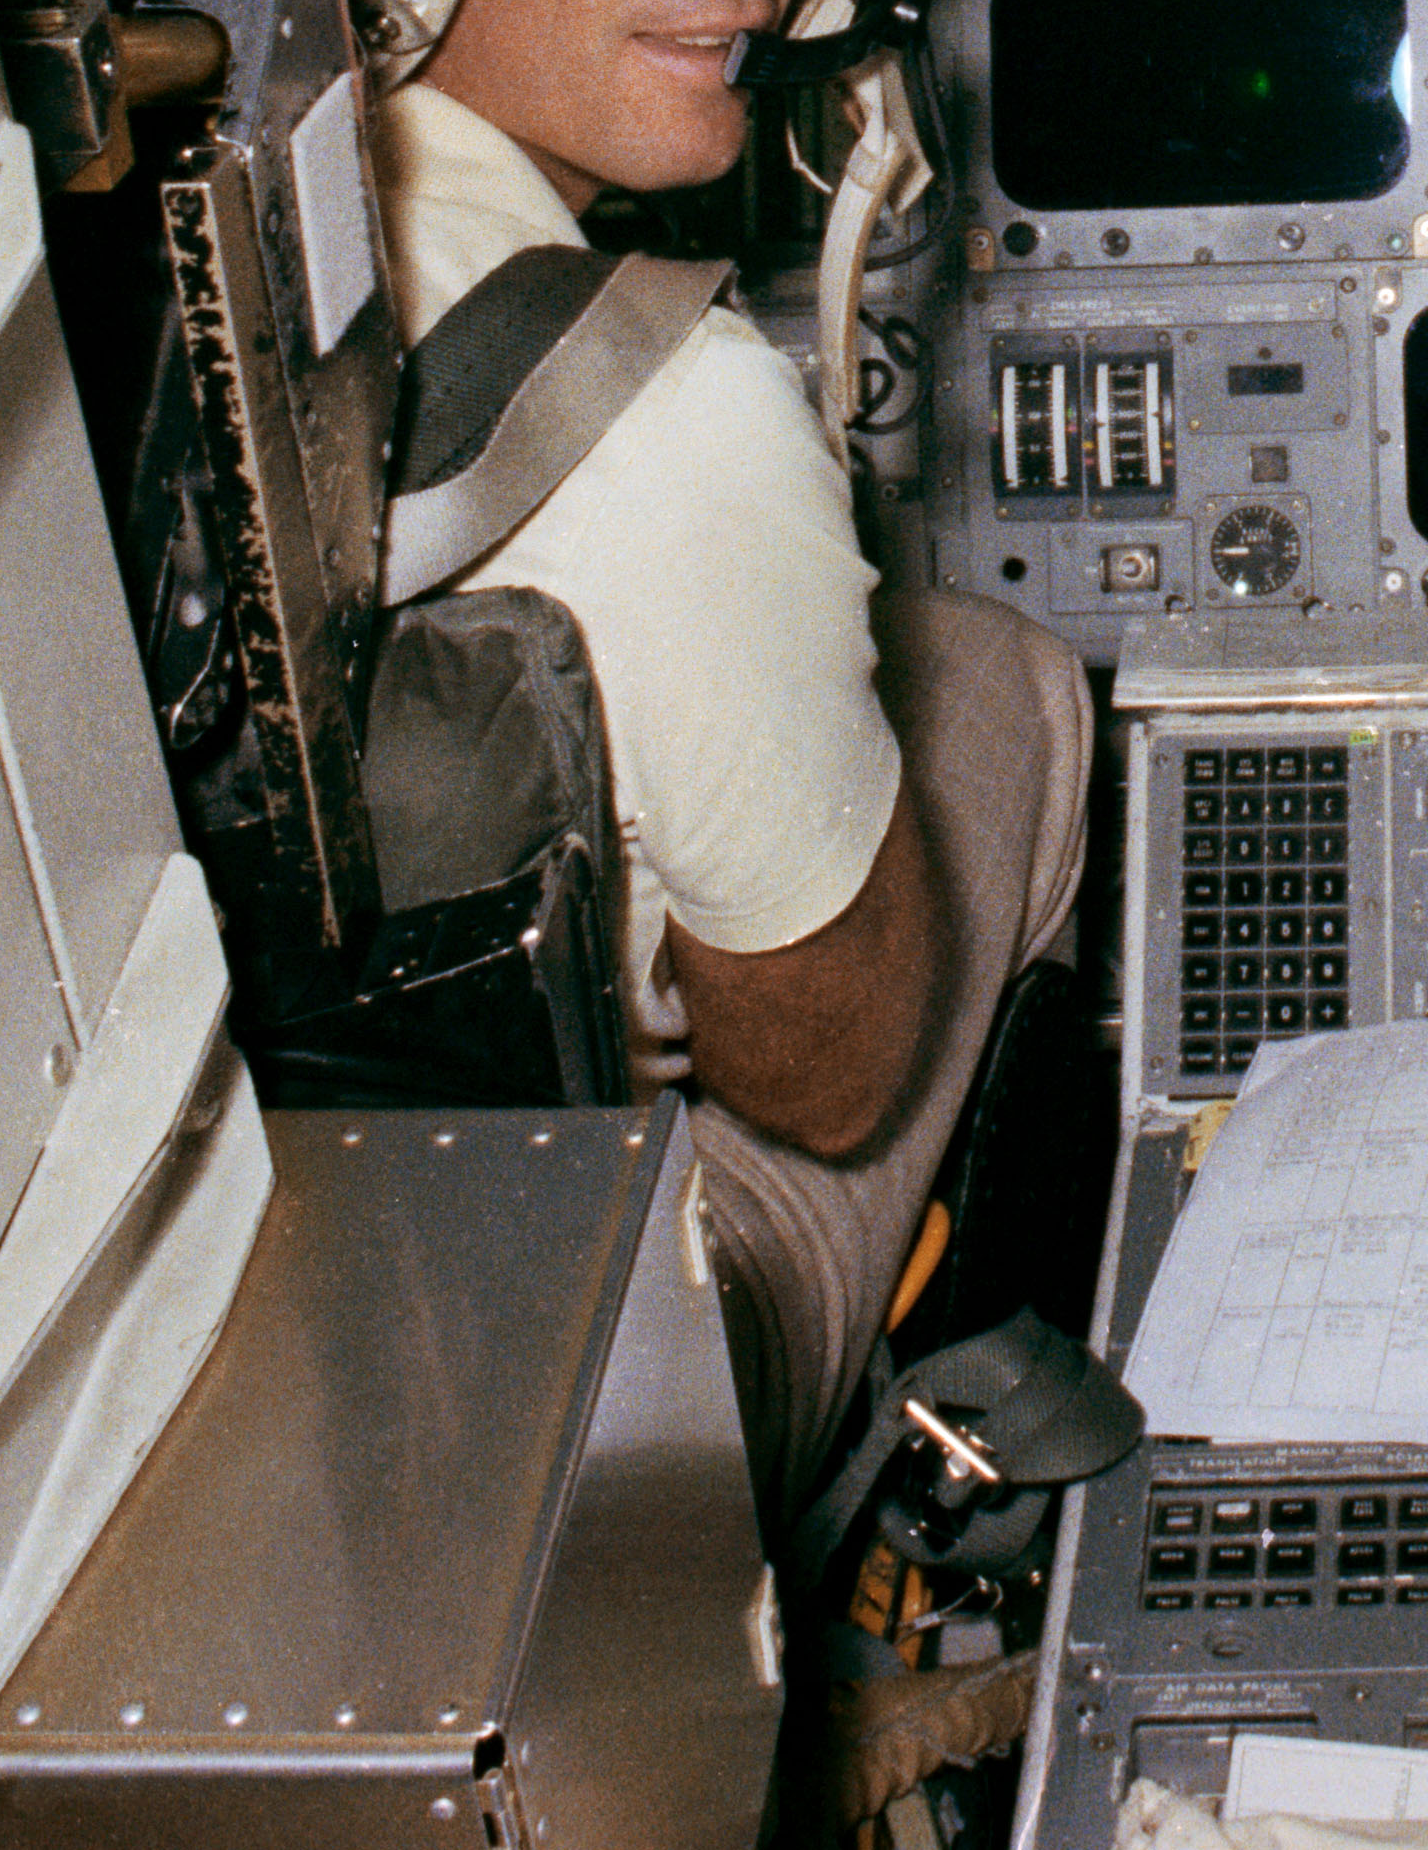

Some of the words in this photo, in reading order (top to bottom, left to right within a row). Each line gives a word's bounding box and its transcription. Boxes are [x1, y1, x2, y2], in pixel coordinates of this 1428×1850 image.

[1241, 801, 1249, 814] A
[1243, 882, 1248, 896] 1
[1283, 881, 1291, 896] 2
[1325, 880, 1333, 895] 3
[1240, 923, 1249, 937] 4
[1281, 922, 1291, 937] 5
[1239, 965, 1248, 980] 7
[1282, 964, 1291, 979] 8
[1281, 1006, 1291, 1020] 0
[1190, 1458, 1287, 1468] TRANSLATION
[1165, 1683, 1189, 1693] AIR
[1195, 1682, 1235, 1692] DATA
[1241, 1681, 1291, 1691] PROBE
